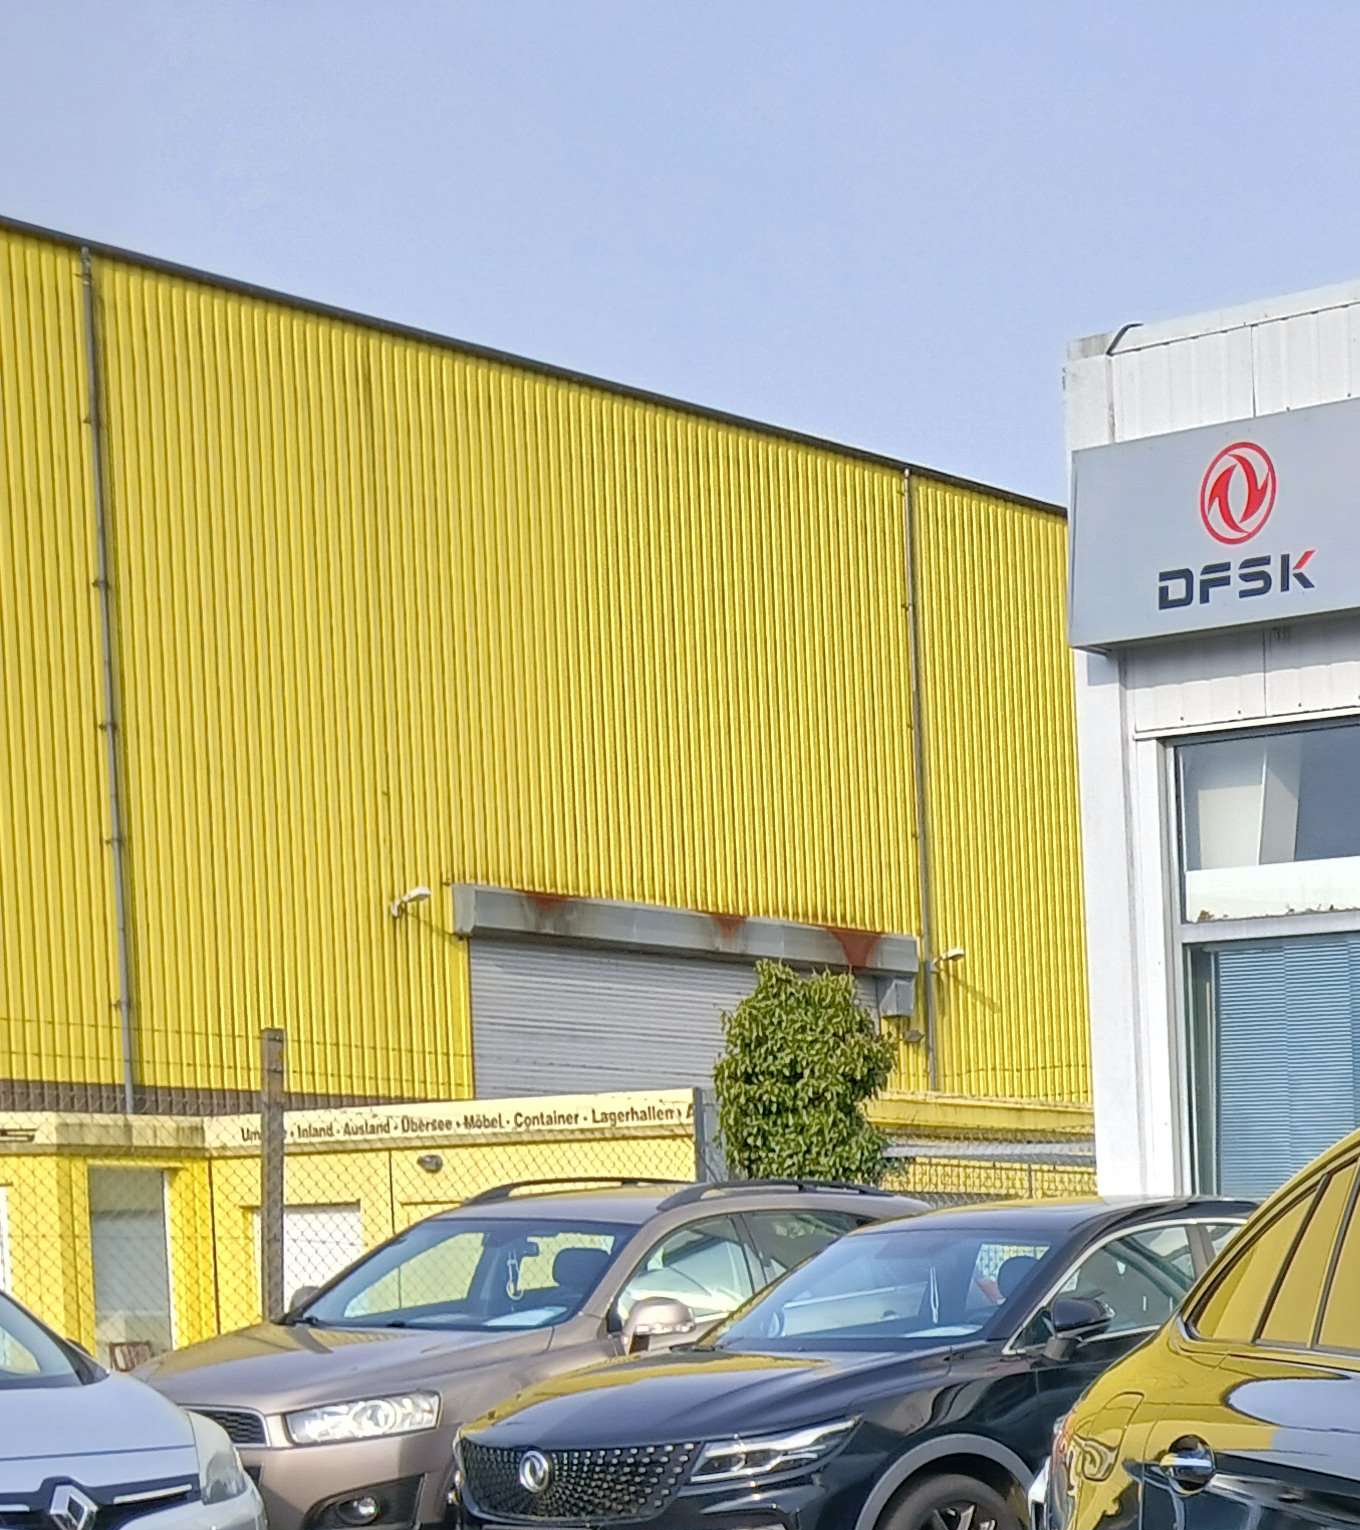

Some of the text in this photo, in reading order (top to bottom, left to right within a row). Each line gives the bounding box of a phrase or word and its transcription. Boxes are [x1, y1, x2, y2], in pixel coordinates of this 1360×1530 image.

[1158, 549, 1316, 611] DFSK
[297, 1122, 335, 1139] Inland
[343, 1115, 391, 1136] Ausland
[463, 1112, 504, 1130] Möbel
[513, 1109, 579, 1129] Container
[592, 1105, 675, 1127] Lagerhallen
